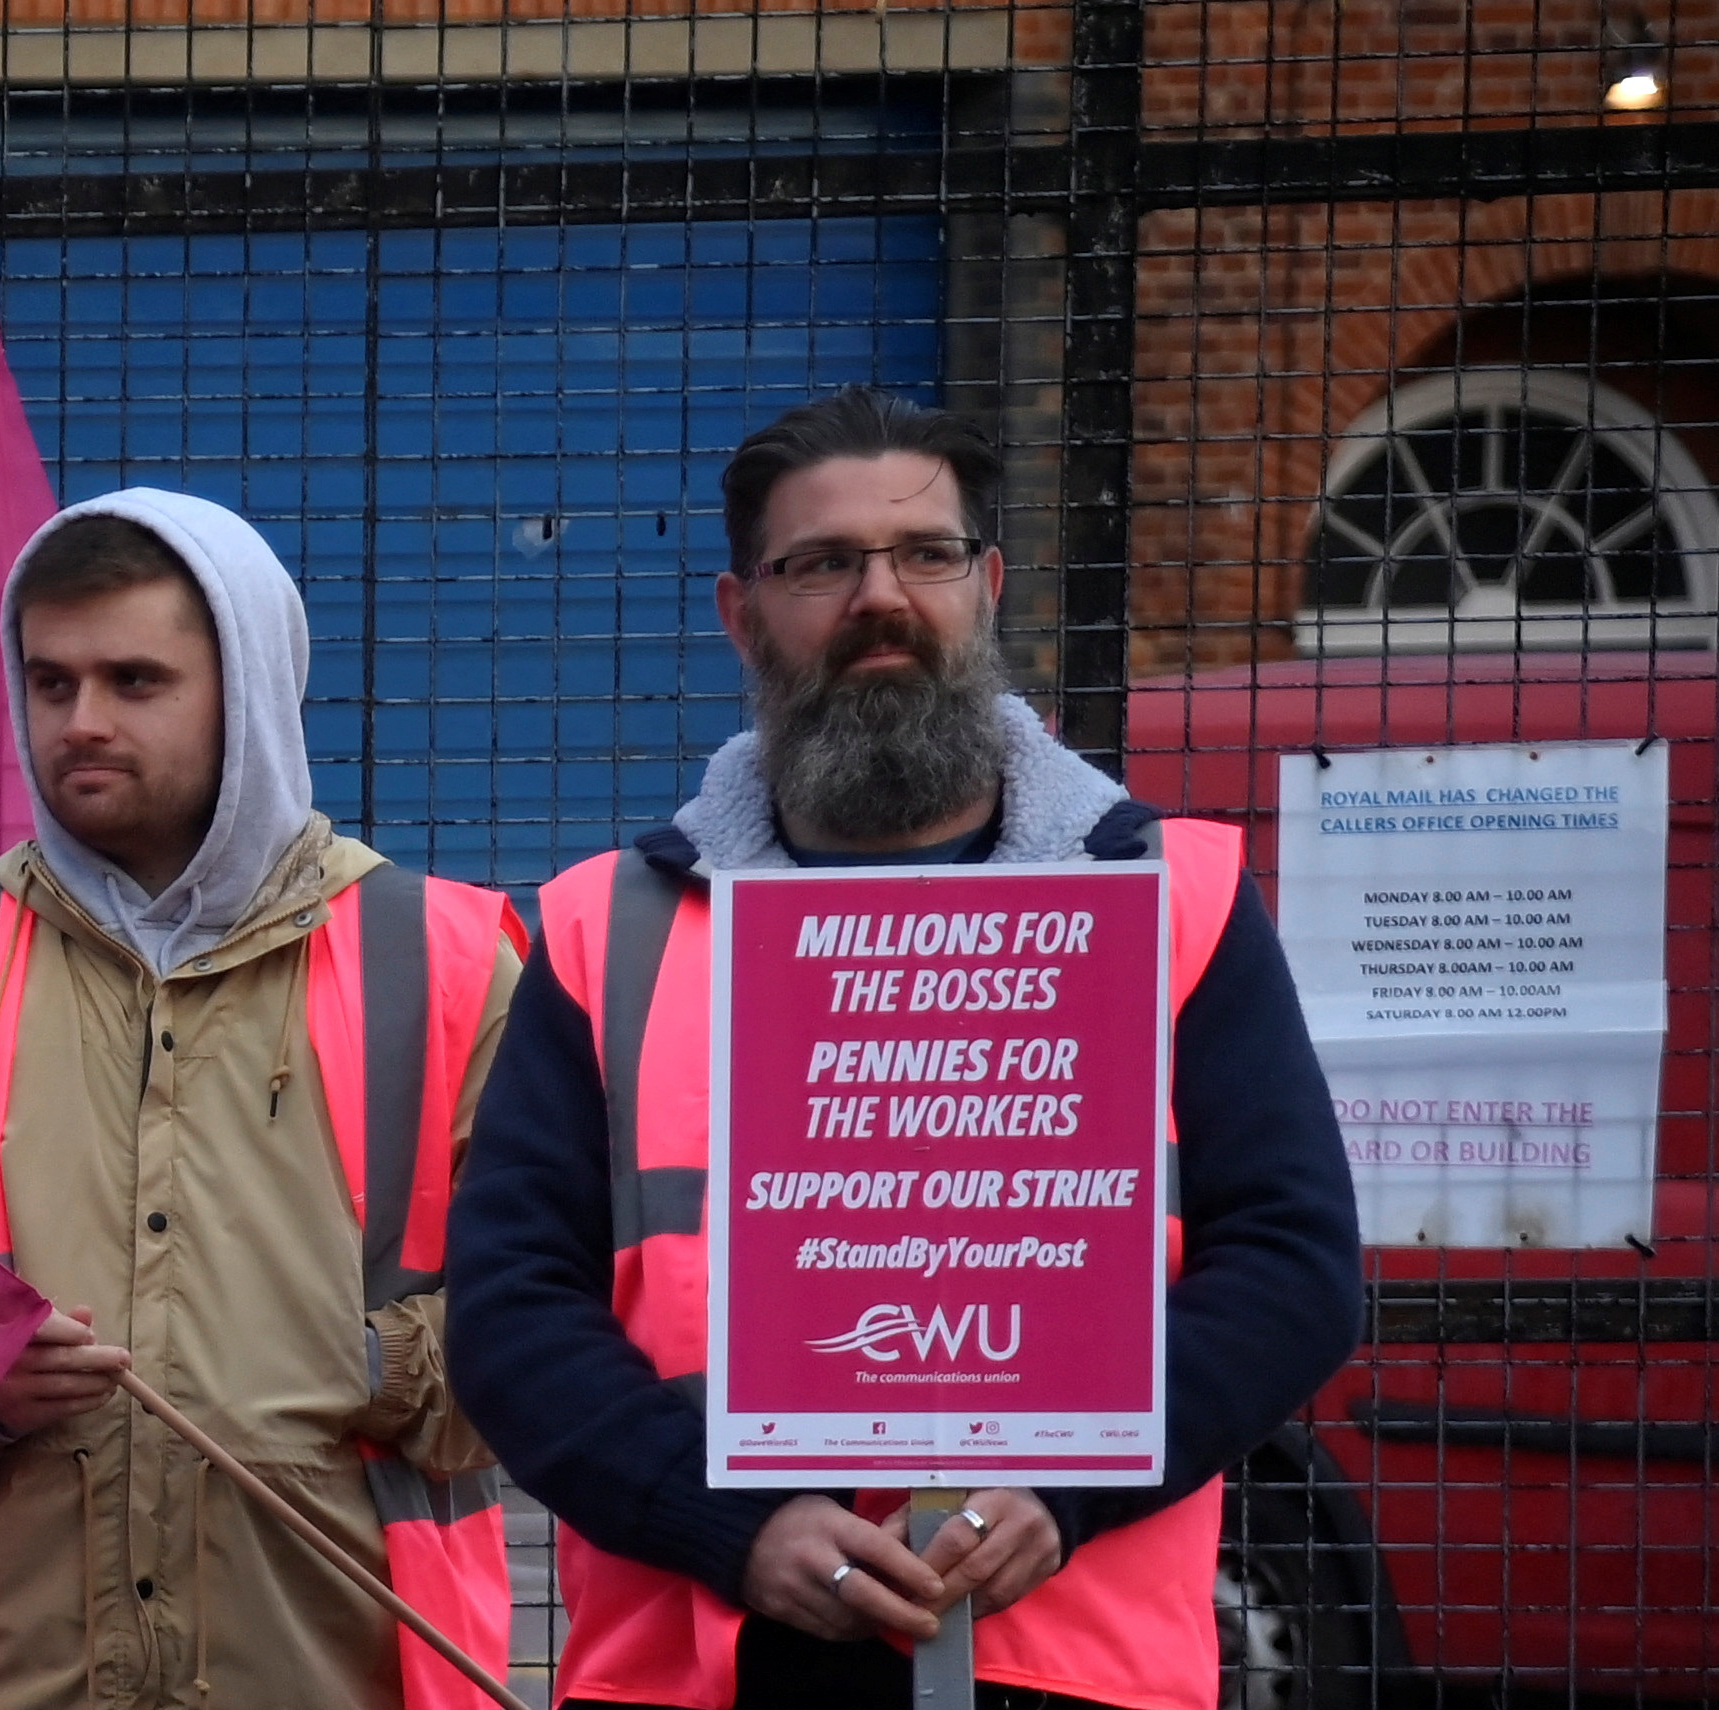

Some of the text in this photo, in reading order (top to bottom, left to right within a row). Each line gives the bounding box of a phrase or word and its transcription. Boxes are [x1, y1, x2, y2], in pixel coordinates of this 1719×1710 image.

[1321, 785, 1618, 807] ROYAL MAIL HAS CHANGED THE
[1320, 812, 1618, 833] CALLERS OFFICE OPENING TIMES
[1364, 889, 1572, 904] MONDAY 8.00 AM 10.00 AM
[1364, 913, 1570, 928] TUESDAY 8.00 AM 10.00 AM
[795, 911, 1094, 958] MILLIONS FOR
[1351, 936, 1583, 952] WEDNESDAY 8.00 AM 10.00 AM
[1360, 960, 1574, 976] THURSDAY 8.00AM 10.00 AM
[830, 967, 1060, 1013] THE BOSSES
[1372, 984, 1561, 999] FRIDAY 8.00 AM 10.00AM
[1366, 1006, 1567, 1021] SATURDAY 8.00 AM 12.00PM
[806, 1038, 1079, 1083] PENNIES FOR
[806, 1094, 1082, 1139] THE WORKERS
[1334, 1099, 1592, 1123] DO NOT ENTER THE
[1345, 1141, 1591, 1164] ARD OR BUILDING
[746, 1168, 1139, 1210] SUPPORT OUR STRIKE
[795, 1236, 1088, 1278] #StandByYourPost
[858, 1303, 1021, 1362] CWU
[855, 1371, 1021, 1384] The communications union
